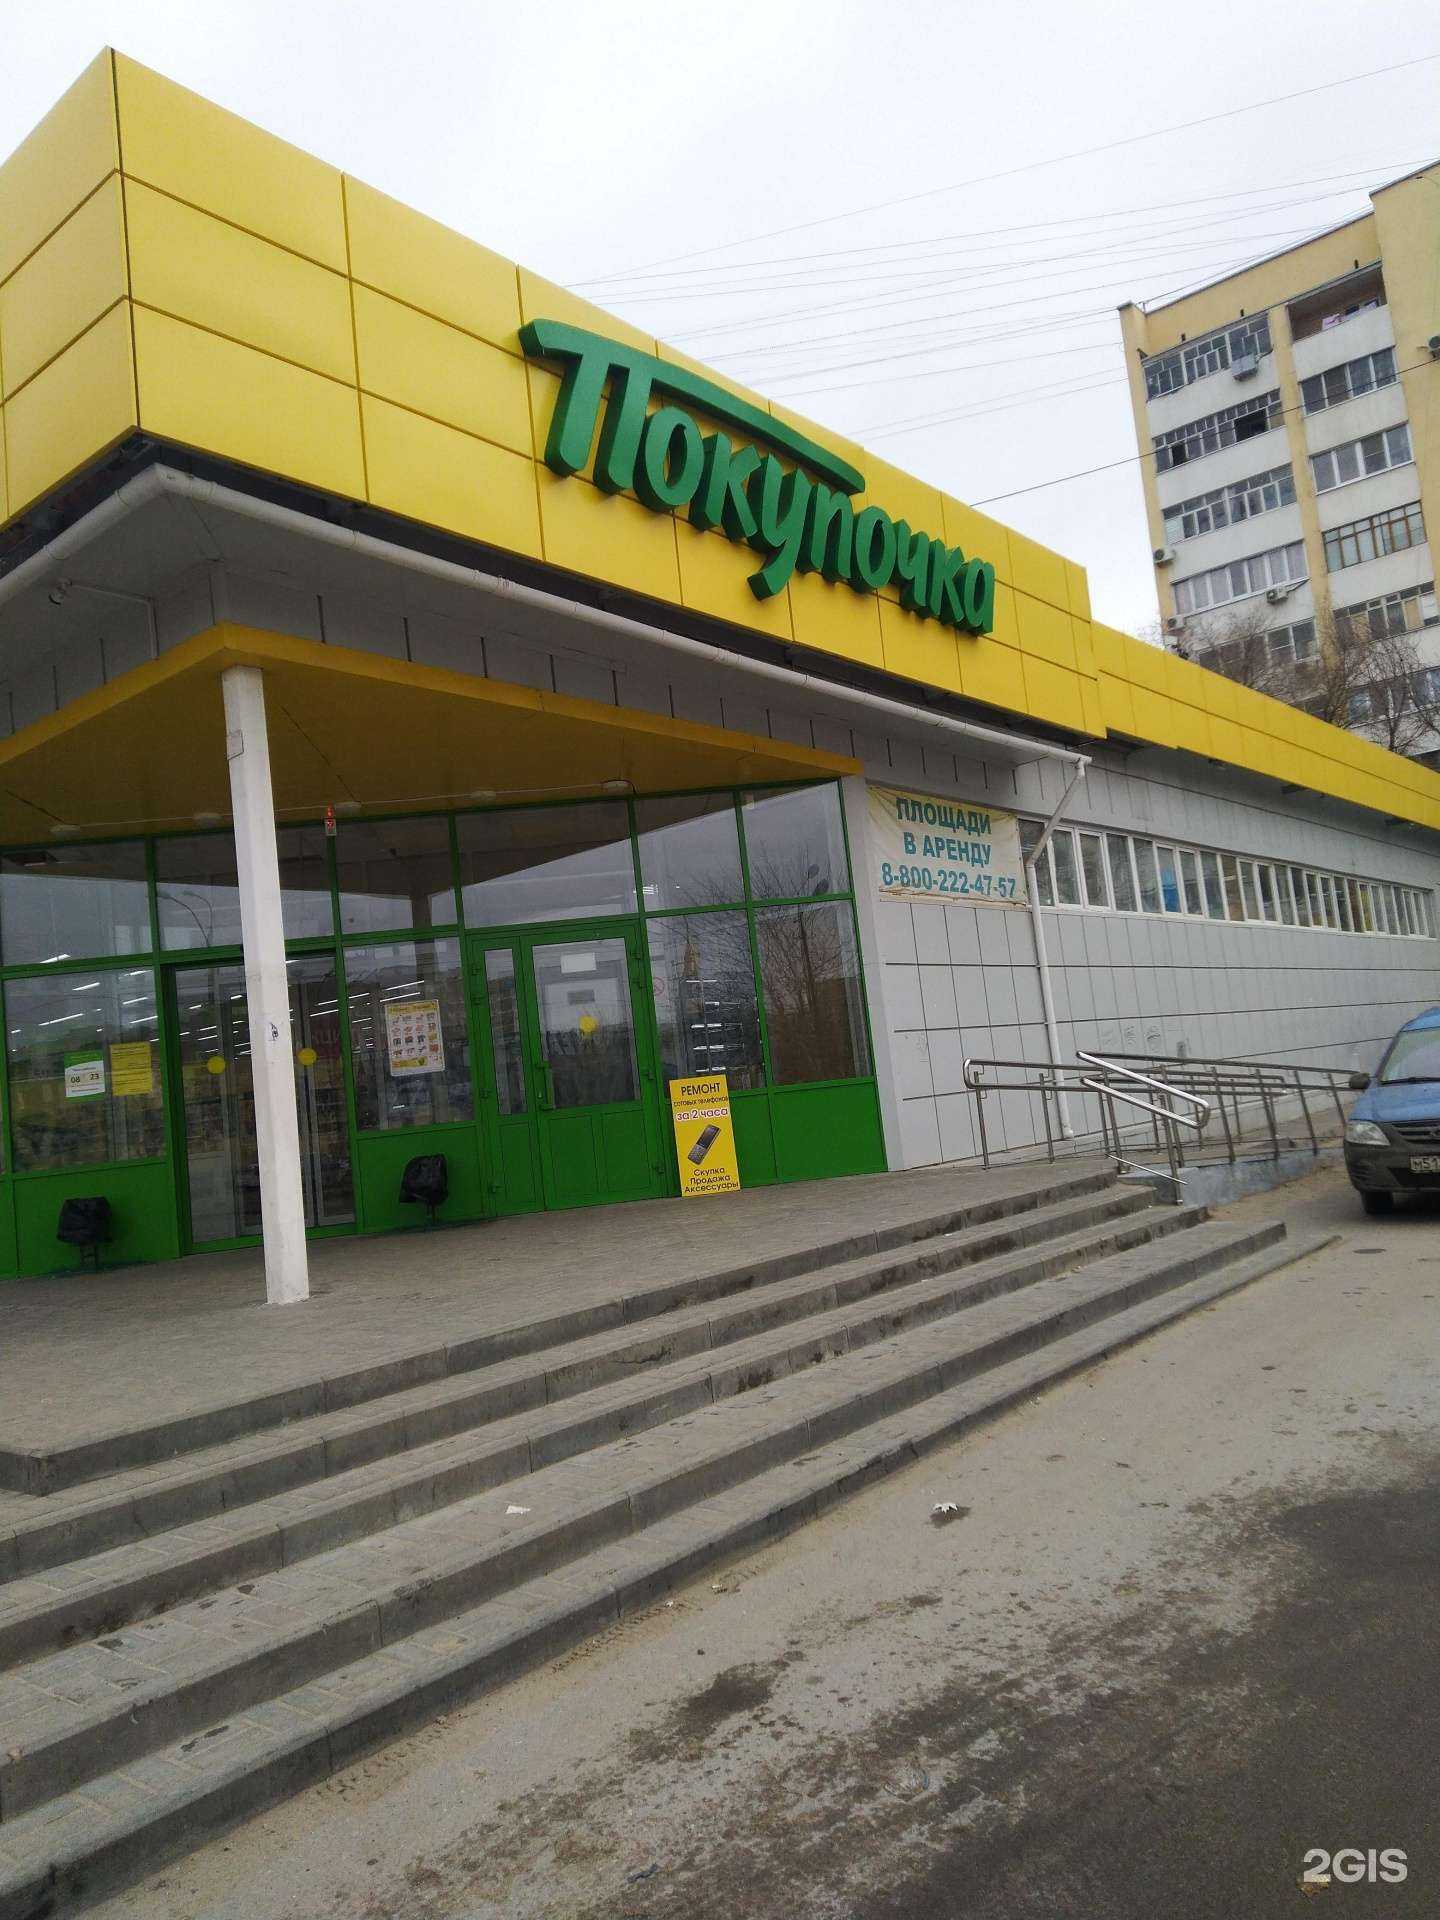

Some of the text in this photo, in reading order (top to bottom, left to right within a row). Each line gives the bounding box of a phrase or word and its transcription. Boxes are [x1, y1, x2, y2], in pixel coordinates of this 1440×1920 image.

[518, 318, 996, 636] Покупочка
[896, 797, 992, 836] ПЛОЩАДИ
[903, 832, 992, 868] В АРЕНДУ
[881, 862, 1016, 898] 8-800-222-47-57
[681, 1083, 720, 1096] РЕМОНТ
[676, 1108, 728, 1121] за 2 часа
[1414, 1157, 1440, 1170] М51
[693, 1167, 725, 1176] Скупка
[690, 1175, 730, 1186] Продажа
[685, 1182, 739, 1193] Аксессуары
